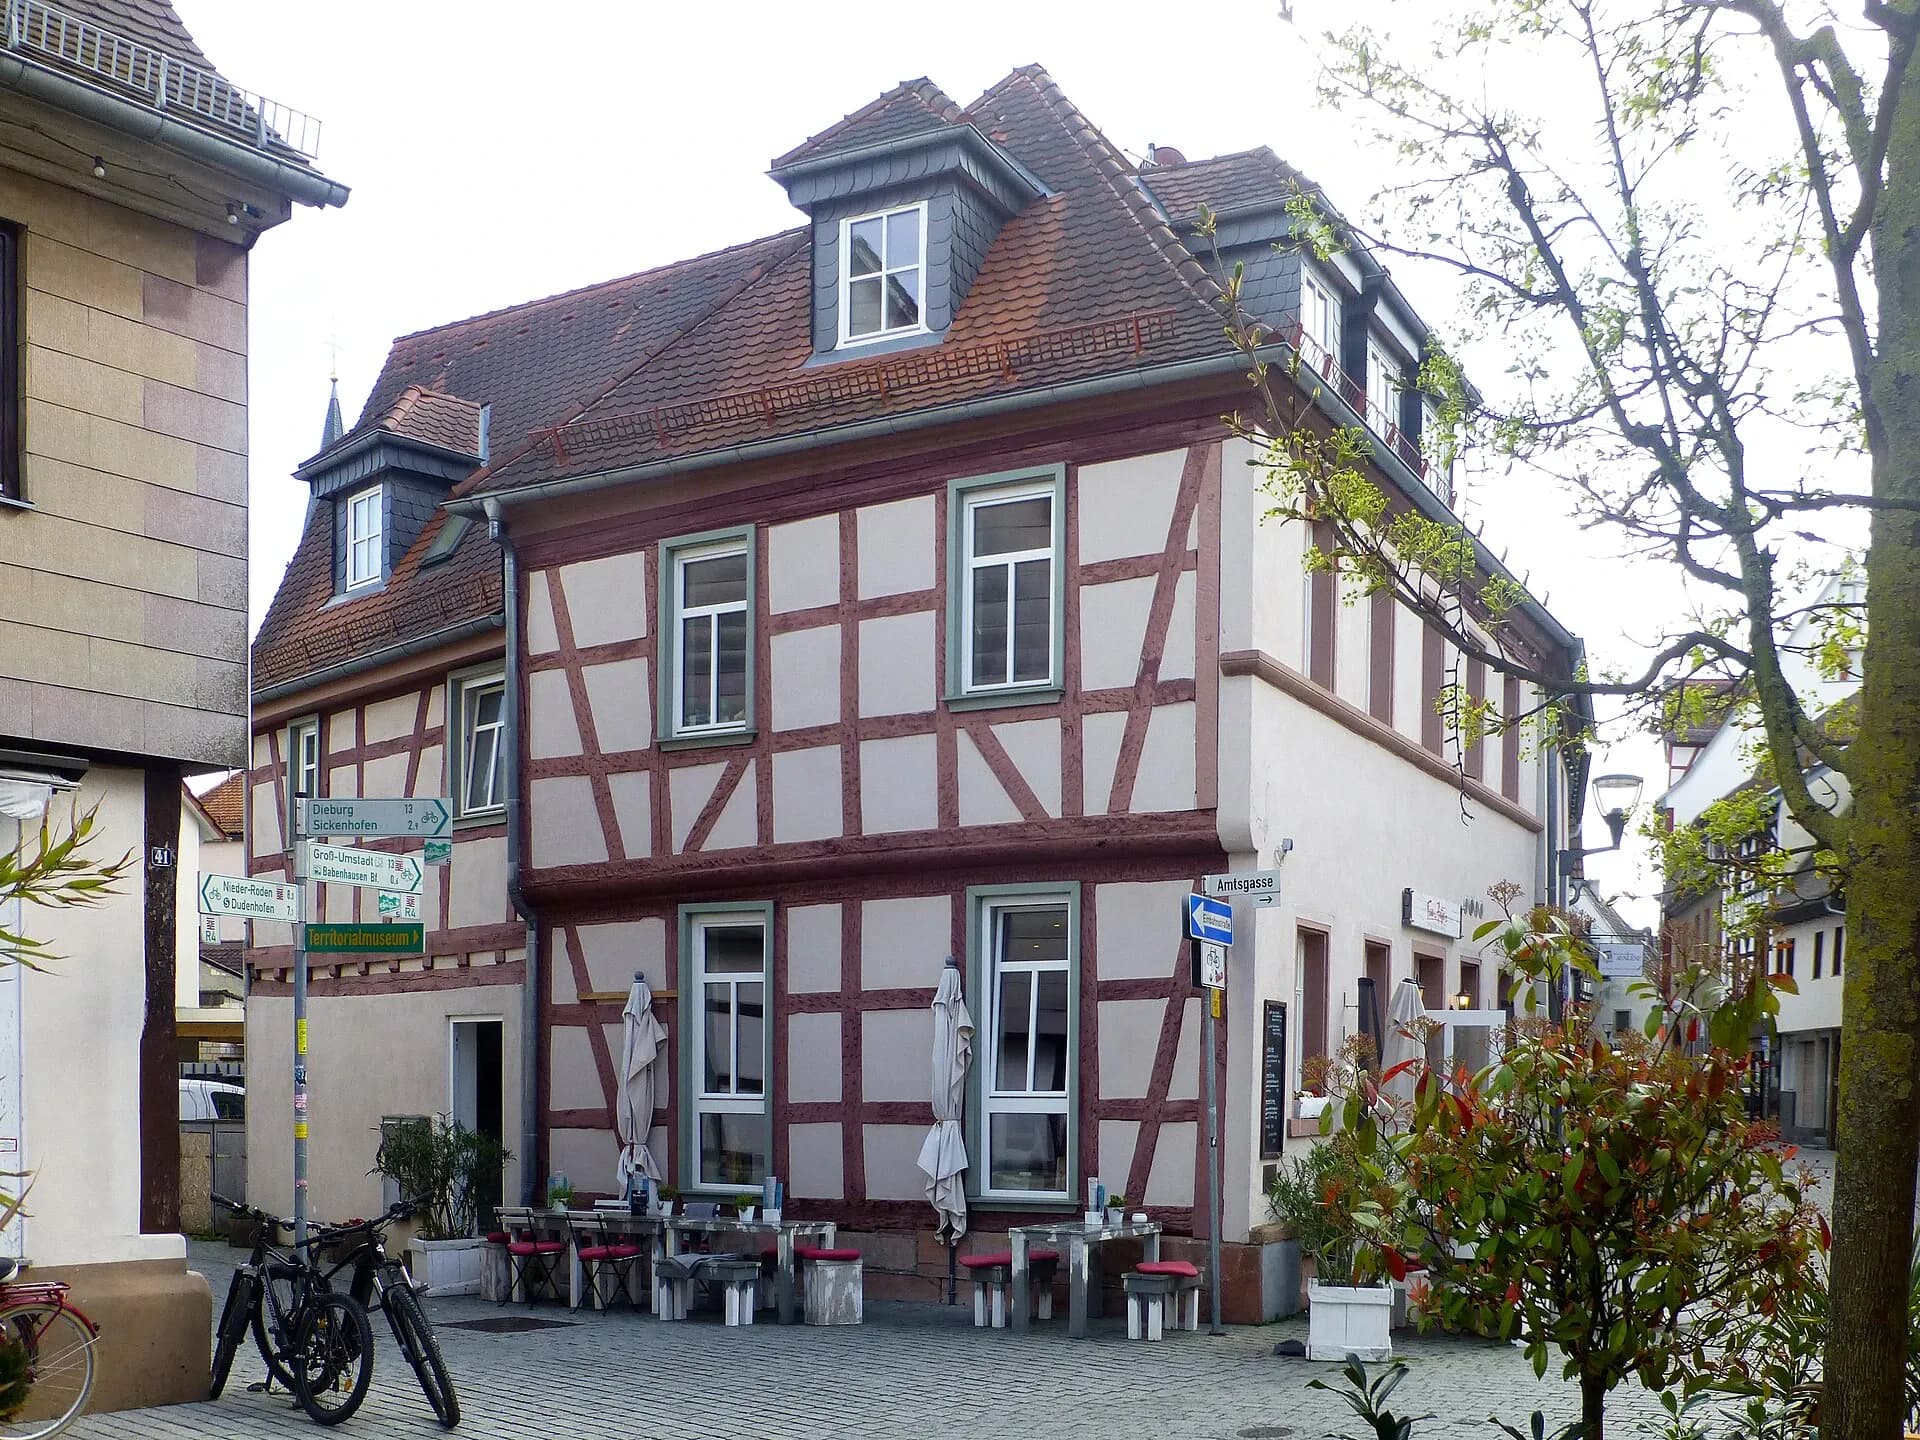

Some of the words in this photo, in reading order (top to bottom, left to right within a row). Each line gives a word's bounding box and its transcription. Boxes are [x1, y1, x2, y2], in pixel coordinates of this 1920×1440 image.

[313, 804, 354, 817] Dieburg
[404, 803, 413, 814] 13
[313, 820, 378, 831] Sickenhofen
[155, 850, 168, 864] 41
[313, 848, 374, 866] Groß-Umstadt
[388, 859, 395, 869] 13
[322, 866, 368, 881] Babenhausen
[223, 881, 273, 898] Nieder-Roden
[1217, 877, 1273, 893] Amtsgasse
[231, 898, 275, 914] Dudenhofen
[405, 907, 416, 917] R4
[205, 931, 216, 942] R4
[308, 927, 409, 946] Territorialmuseum
